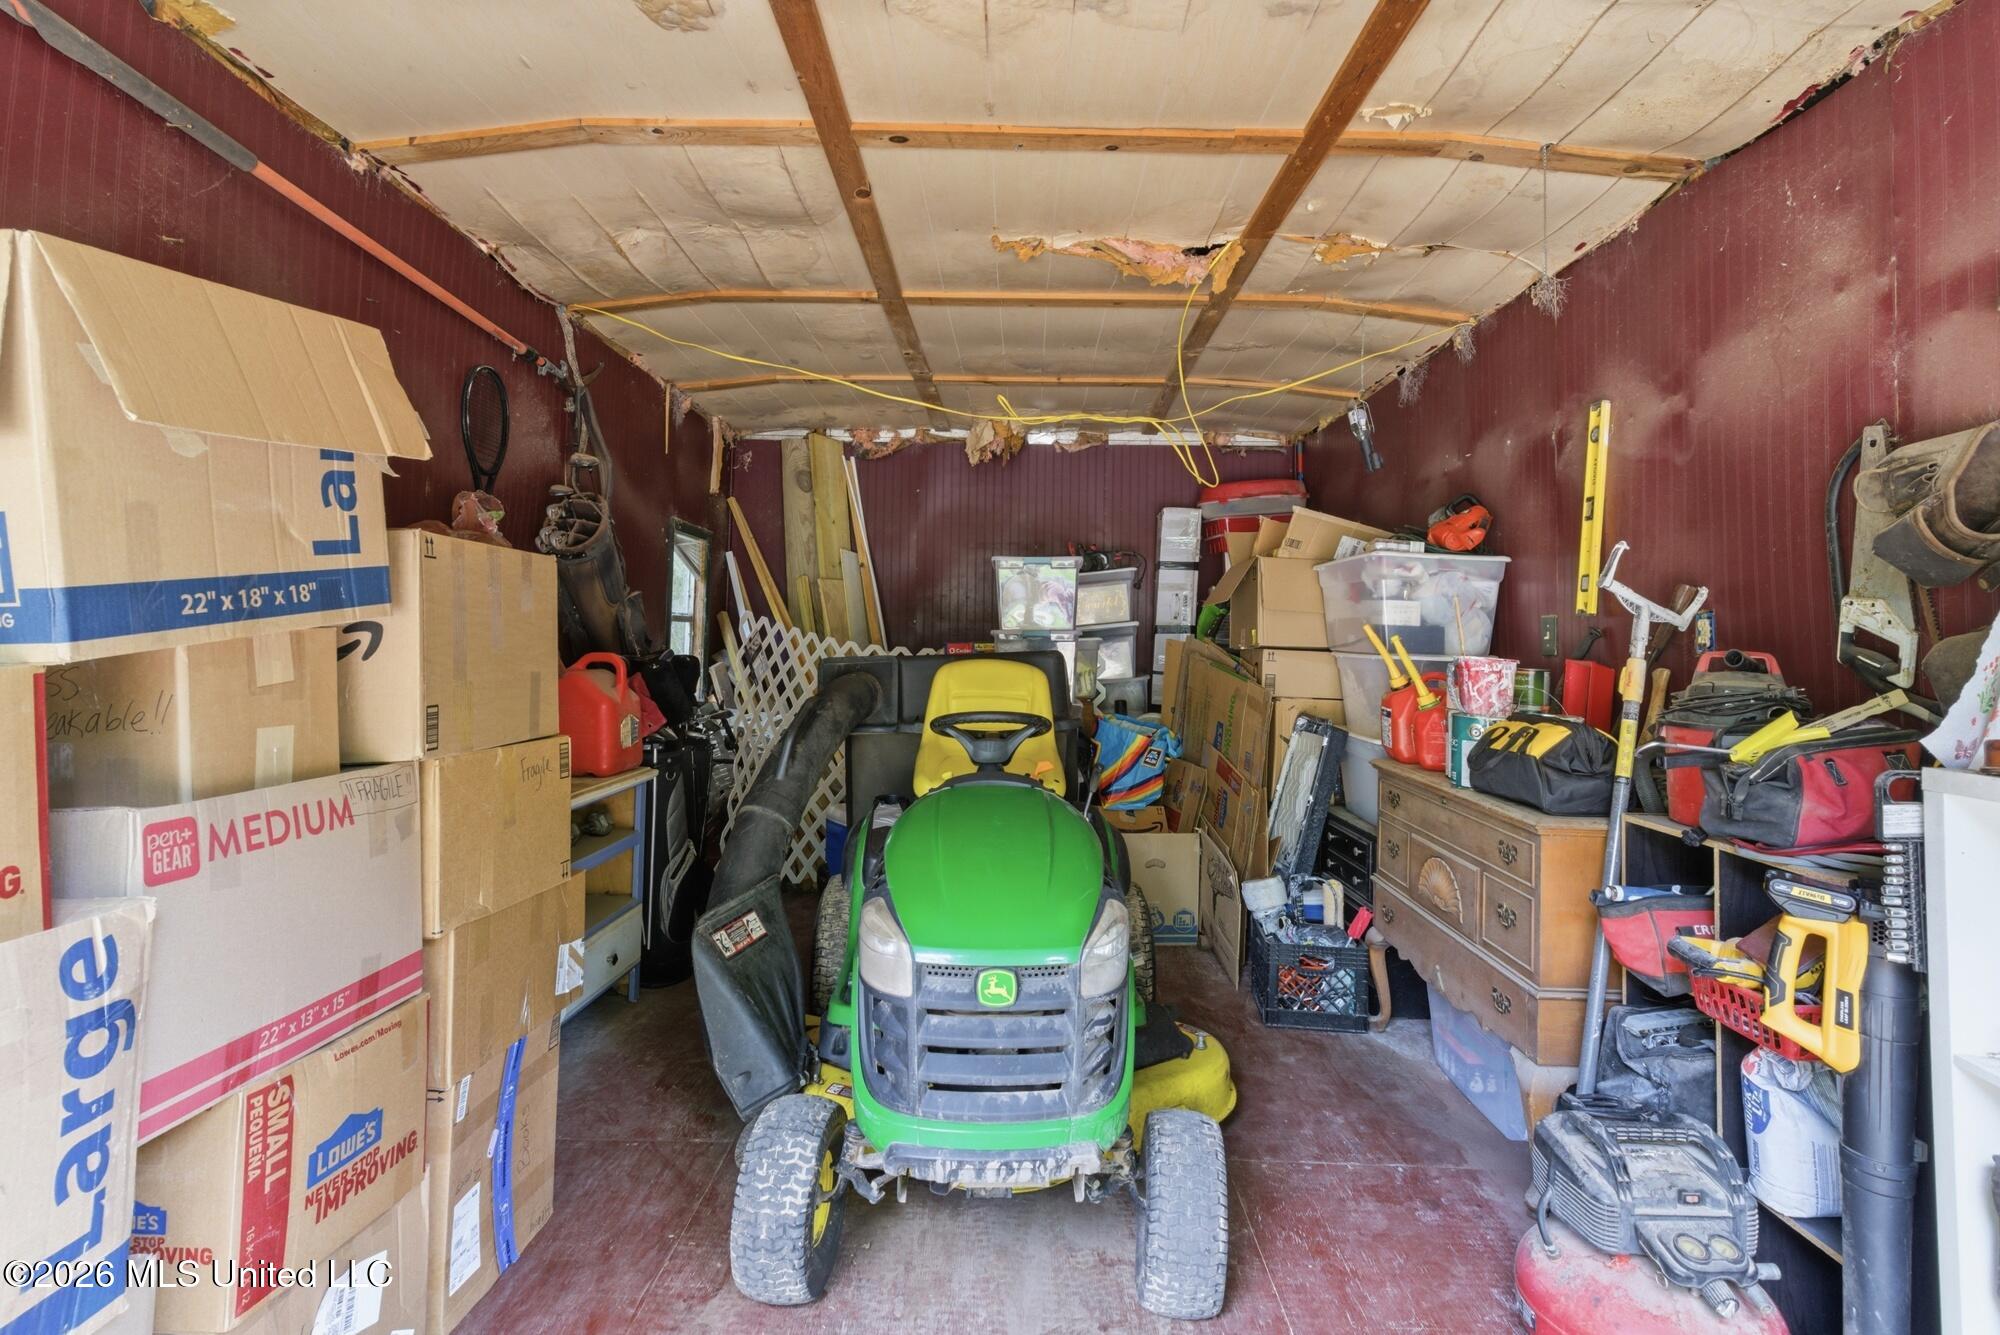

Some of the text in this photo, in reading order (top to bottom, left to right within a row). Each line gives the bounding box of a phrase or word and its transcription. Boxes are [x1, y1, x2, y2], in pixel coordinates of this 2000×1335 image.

[180, 582, 317, 617] 22" x 18" x 18"
[47, 690, 174, 740] eakable!!
[520, 755, 553, 792] Fragile
[147, 828, 193, 858] pen+
[208, 794, 355, 862] MEDIUM
[152, 844, 193, 876] GEAR
[259, 1023, 286, 1050] 22"
[299, 1006, 321, 1029] 13"
[331, 990, 351, 1011] 15"
[333, 1018, 402, 1062] Lowes.com/Moving
[19, 932, 137, 1295] Large
[264, 1083, 291, 1194] SMALL
[247, 1097, 265, 1184] PEQUEÑA
[316, 1121, 377, 1177] LOWE'S
[304, 1146, 381, 1211] NEVER STOP
[132, 1213, 159, 1231] E'S
